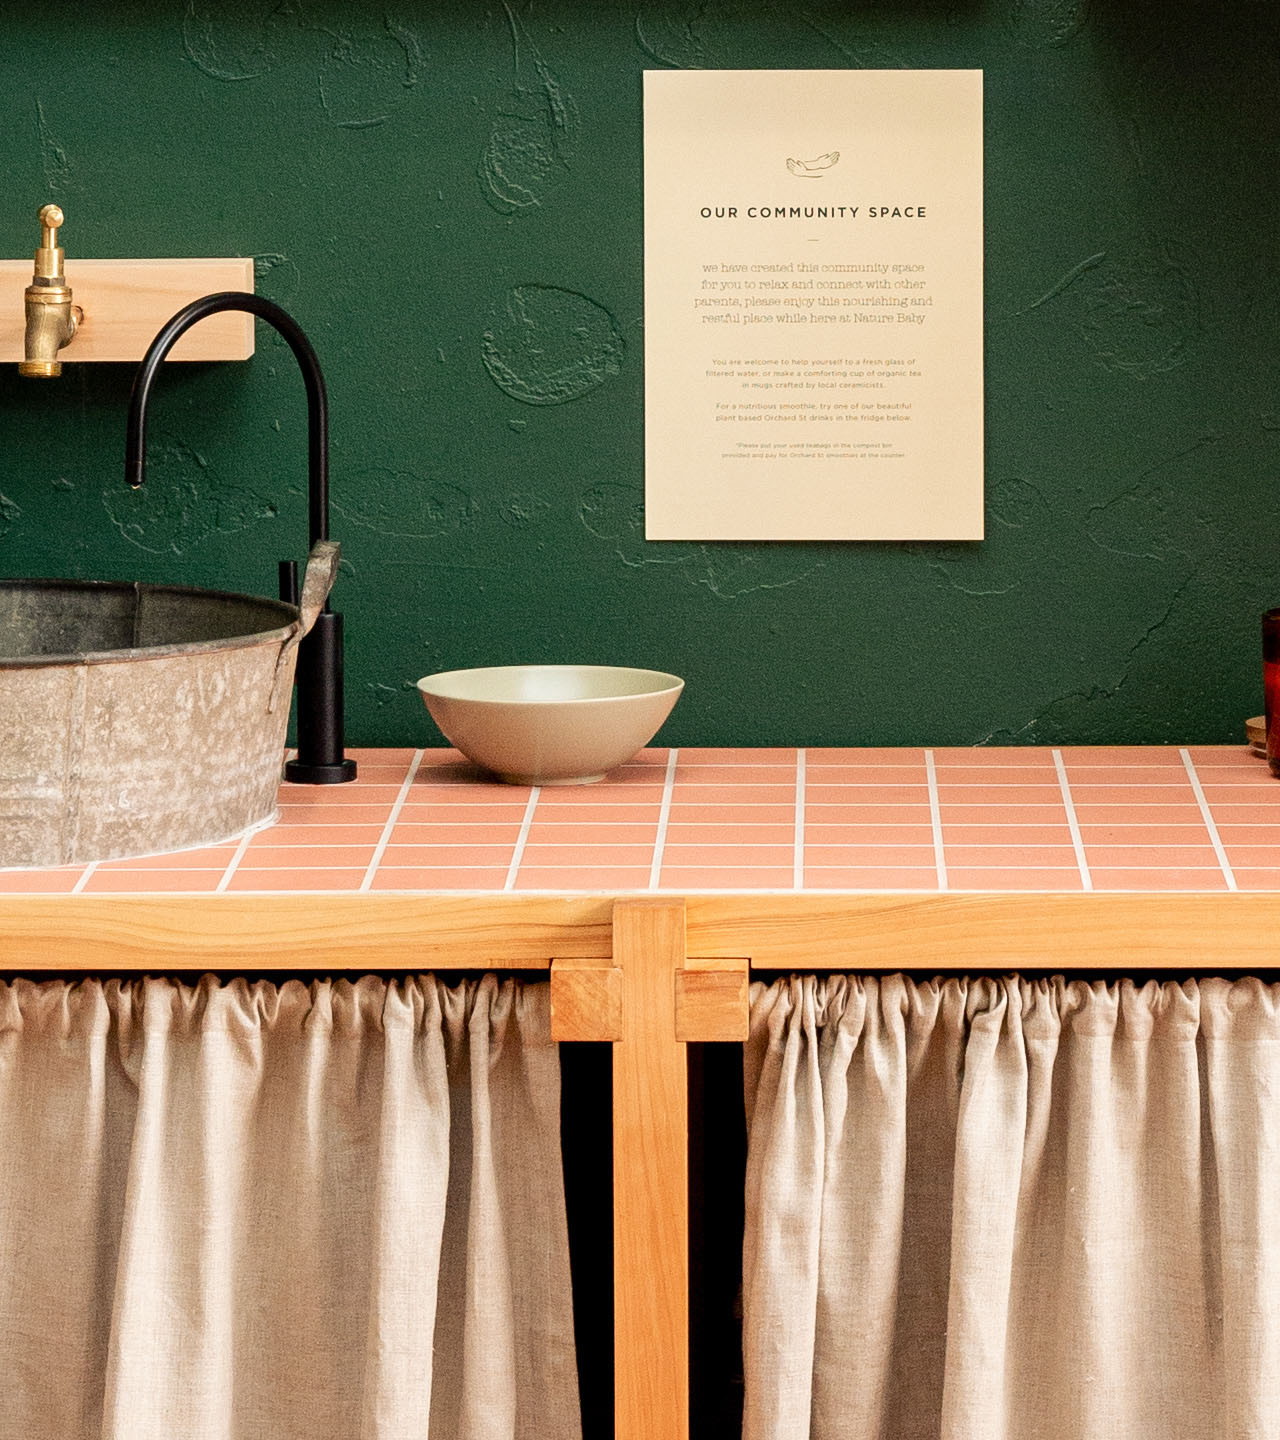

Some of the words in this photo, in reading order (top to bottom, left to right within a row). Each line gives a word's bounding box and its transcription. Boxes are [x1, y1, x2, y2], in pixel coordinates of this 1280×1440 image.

[700, 206, 738, 218] OUR
[747, 206, 860, 218] COMMUNITY
[868, 206, 927, 218] SPACE
[702, 264, 719, 272] we
[721, 262, 748, 272] have
[750, 262, 794, 272] created
[797, 262, 819, 272] this
[821, 262, 888, 276] community
[891, 264, 925, 276] space
[701, 278, 719, 289] for
[719, 281, 742, 292] you
[744, 278, 756, 289] to
[758, 278, 789, 289] relax
[791, 278, 814, 289] and
[815, 278, 863, 289] connect
[865, 278, 892, 289] with
[894, 278, 927, 289] other
[693, 295, 742, 309] parents,
[744, 295, 781, 309] please
[783, 298, 815, 309] enjoy
[817, 295, 840, 306] this
[842, 295, 909, 309] nourishing
[910, 295, 933, 306] and
[701, 312, 740, 323] restful
[743, 312, 774, 326] place
[775, 312, 808, 323] while
[809, 312, 836, 323] here
[838, 312, 851, 323] at
[853, 312, 894, 323] Nature
[897, 312, 926, 326] Baby
[791, 359, 809, 367] help
[811, 359, 843, 367] yourself
[884, 359, 905, 367] glass
[803, 370, 848, 379] comforting
[849, 371, 865, 379] cup
[876, 370, 907, 379] organic
[805, 382, 815, 390] by
[820, 403, 831, 411] try
[715, 414, 736, 423] plant
[860, 414, 885, 423] fridge
